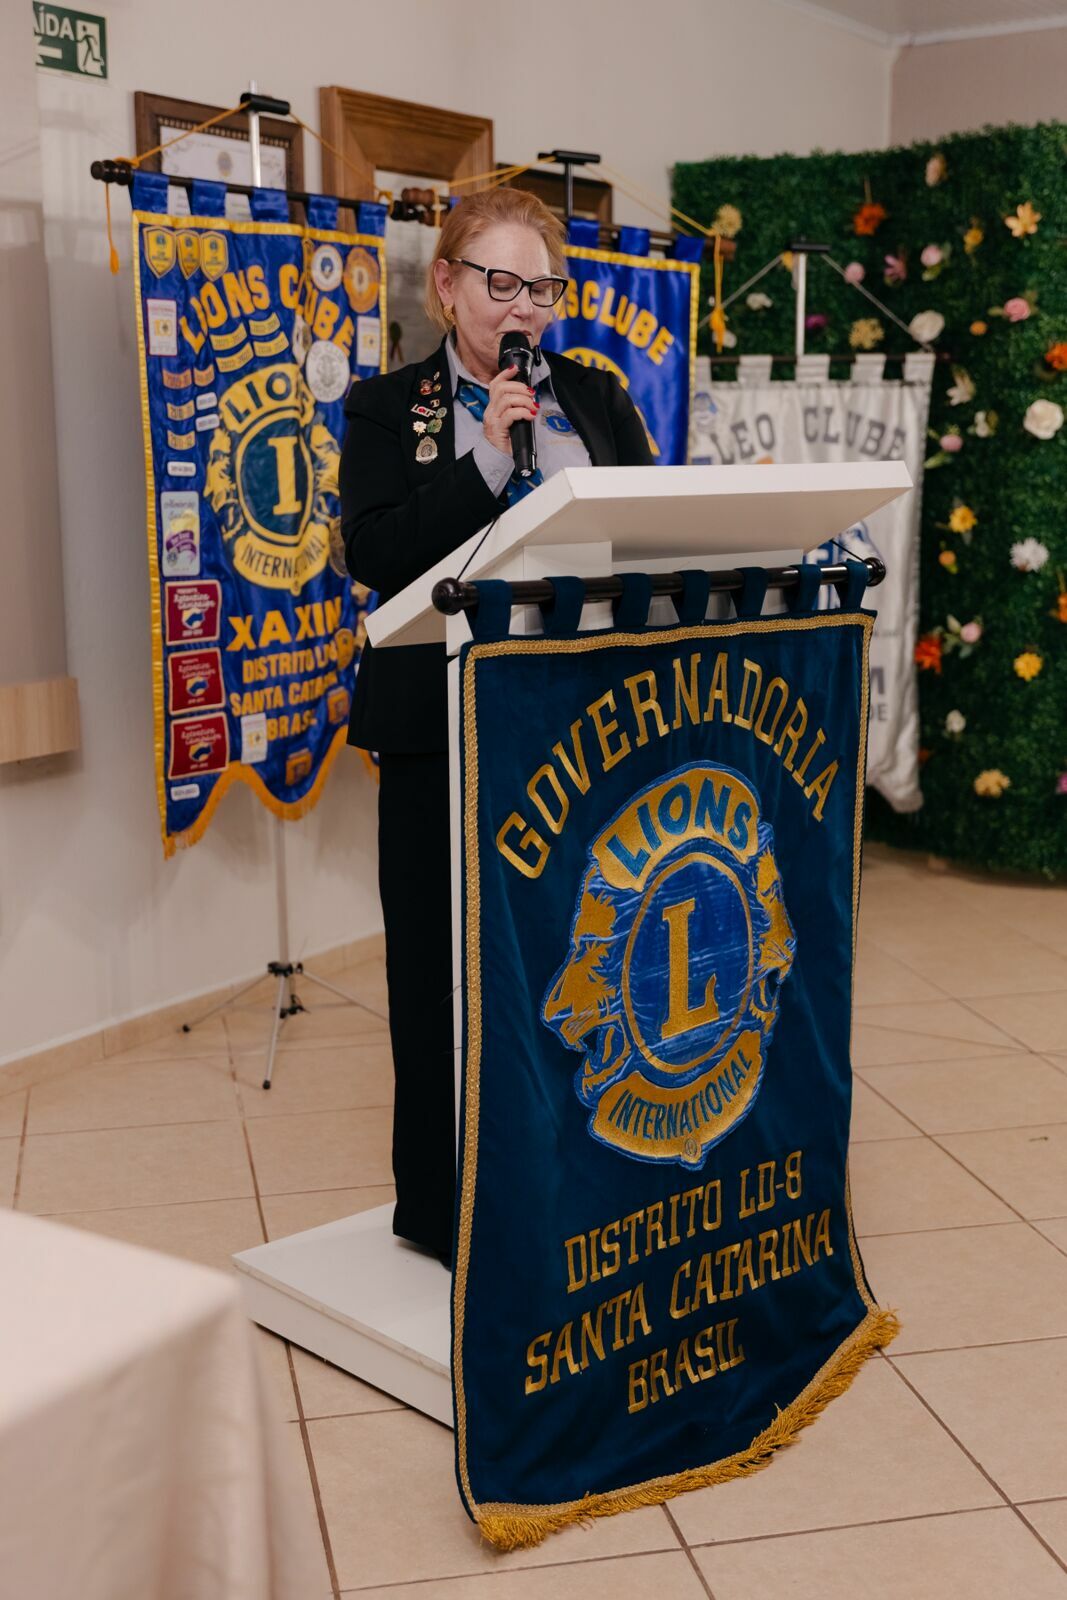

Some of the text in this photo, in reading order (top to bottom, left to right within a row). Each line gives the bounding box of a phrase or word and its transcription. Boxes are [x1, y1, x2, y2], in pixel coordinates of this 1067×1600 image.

[33, 5, 75, 41] ÍDA
[180, 265, 270, 354] LIONS
[225, 371, 309, 424] LIO
[711, 407, 905, 464] LEO CLUBE
[229, 685, 284, 718] SANTA
[266, 709, 318, 741] BRAS
[496, 652, 839, 879] GOVERNADORIA
[606, 778, 752, 879] LIONS
[661, 897, 720, 1039] L
[607, 1049, 753, 1141] INTERNATIONAL
[564, 1150, 803, 1294] DISTRITO LD-8
[525, 1207, 834, 1396] SANTA CATARINA
[627, 1317, 747, 1414] BRASIL
